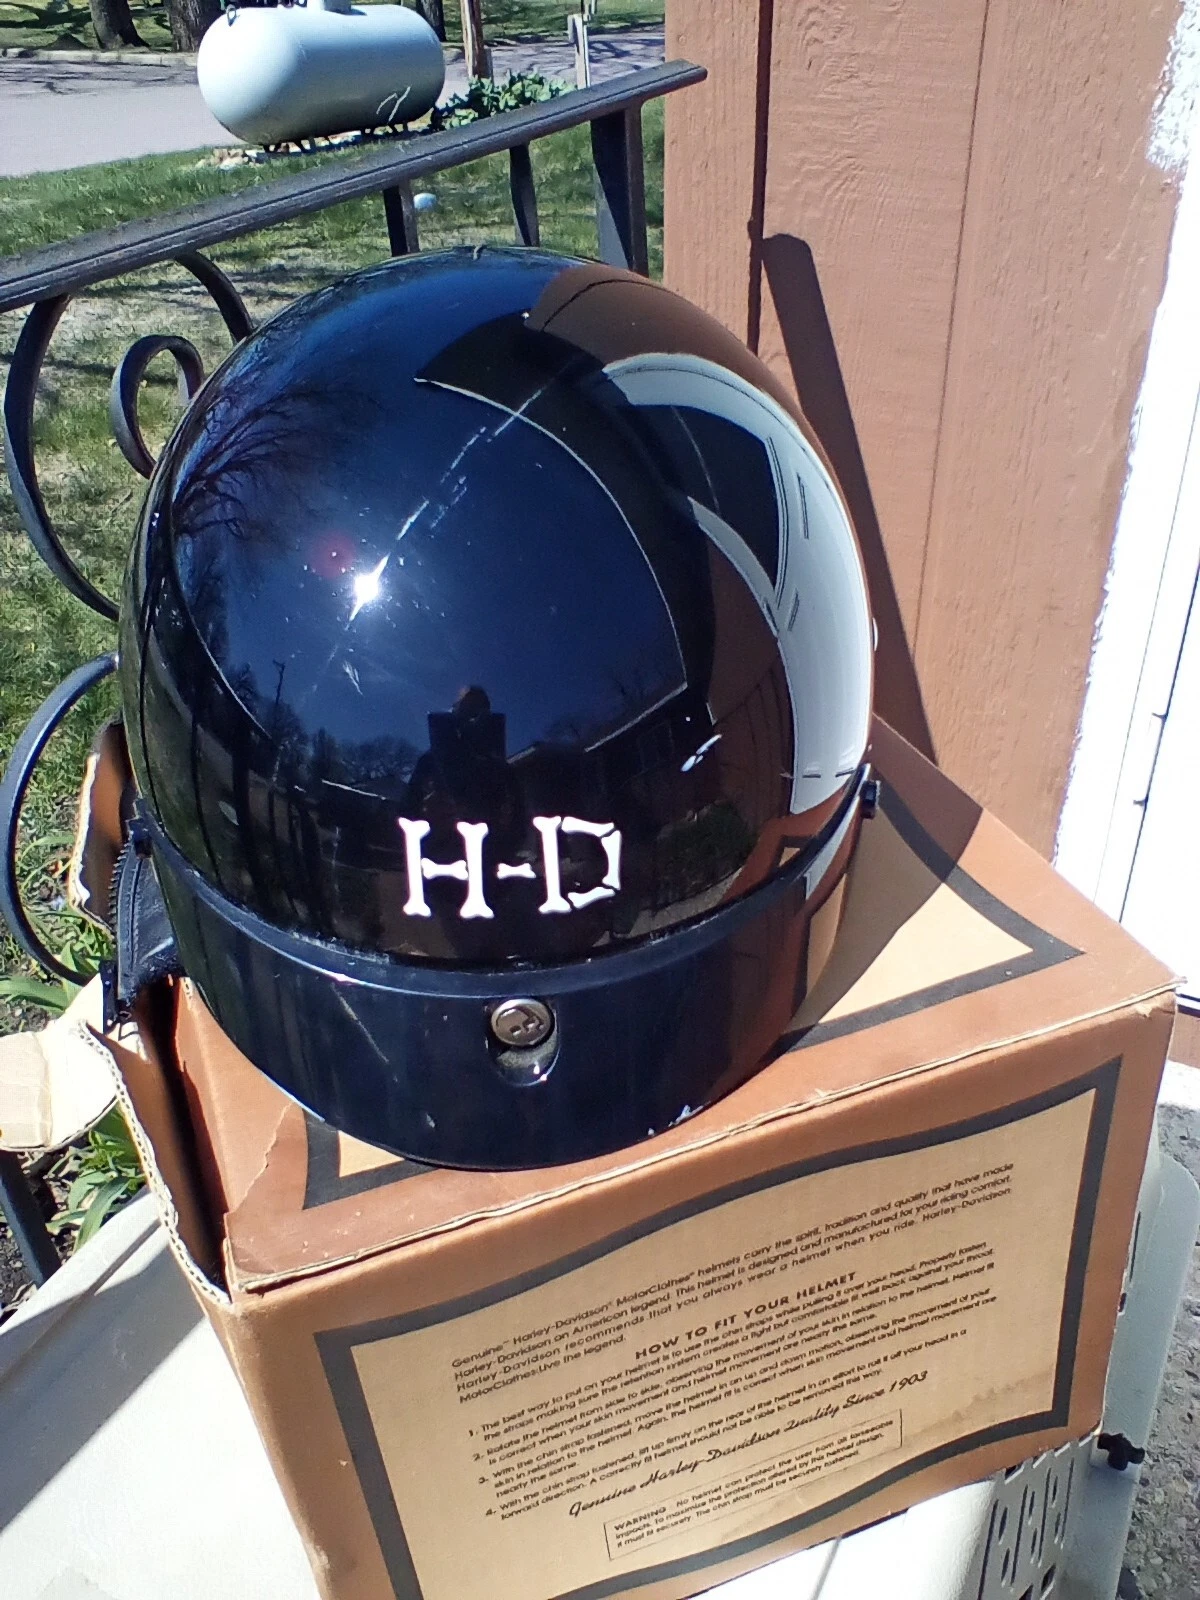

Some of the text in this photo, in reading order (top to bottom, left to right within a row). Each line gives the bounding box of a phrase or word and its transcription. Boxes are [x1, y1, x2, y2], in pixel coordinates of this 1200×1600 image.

[398, 815, 621, 919] H-D
[635, 1271, 856, 1360] HOW TO FIT YOUR HELMET
[568, 1369, 928, 1518] Genuine Harley-Davidson Quality Since 1903
